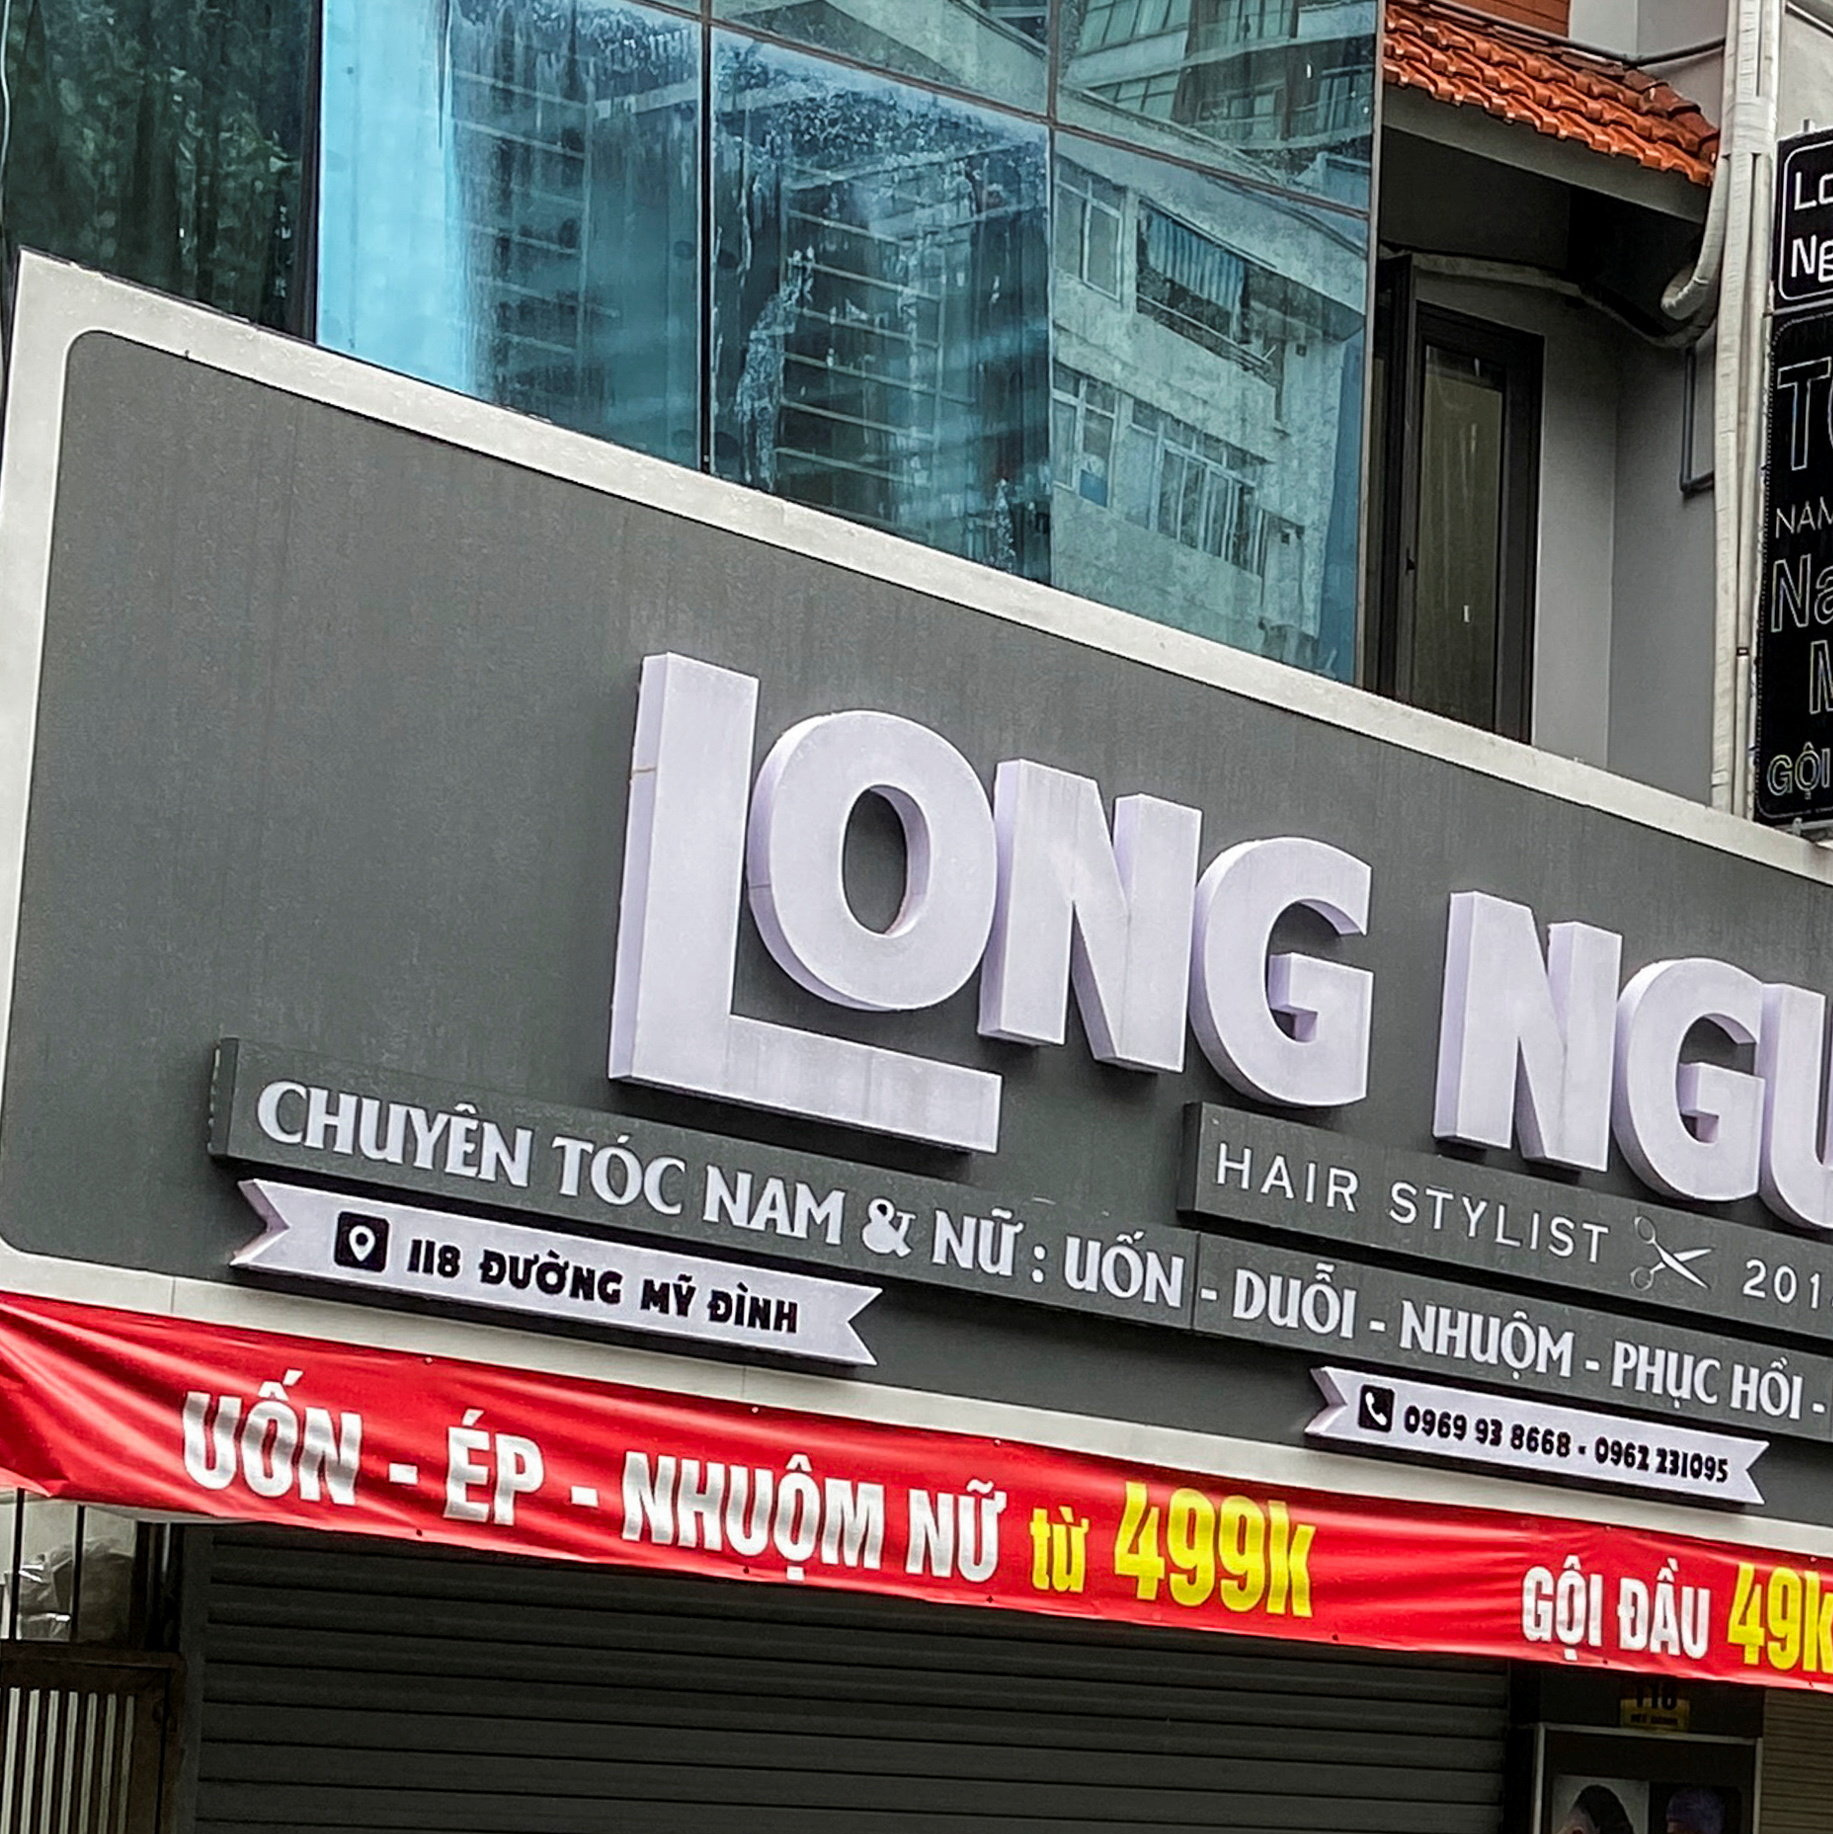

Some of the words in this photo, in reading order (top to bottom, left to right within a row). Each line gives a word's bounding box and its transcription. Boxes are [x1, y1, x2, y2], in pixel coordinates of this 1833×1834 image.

[1767, 742, 1831, 801] GỘI
[609, 651, 1372, 1154] LONG
[256, 1080, 533, 1188] CHUYÊN
[551, 1133, 686, 1215] TÓC
[702, 1163, 845, 1246] NAM
[862, 1198, 916, 1258] &
[931, 1208, 1023, 1277] NỮ
[1063, 1229, 1185, 1308] UỐN
[1232, 1263, 1356, 1340] DUỖI
[1400, 1300, 1575, 1381] NHUỘM
[1611, 1340, 1720, 1410] PHỤC
[1730, 1355, 1803, 1421] HỒI
[1216, 1141, 1360, 1213] HAIR
[1388, 1181, 1612, 1263] STYLIST
[408, 1239, 461, 1279] 118
[479, 1248, 622, 1305] ĐƯỜNG
[640, 1272, 696, 1318] MỸ
[707, 1282, 799, 1333] ĐÌNH
[181, 1370, 363, 1507] UỐN
[442, 1409, 544, 1527] ÉP
[621, 1453, 885, 1582] NHUỘM
[904, 1479, 1007, 1583] NỮ
[1030, 1505, 1090, 1593] từ
[1114, 1480, 1317, 1618] 499k
[1404, 1403, 1468, 1441] 0969
[1475, 1418, 1503, 1447] 93
[1509, 1421, 1571, 1459] 8668
[1594, 1435, 1649, 1471] 0962
[1654, 1446, 1729, 1484] 231095
[1521, 1554, 1603, 1661] GỘI
[1617, 1557, 1710, 1660] ĐẦU
